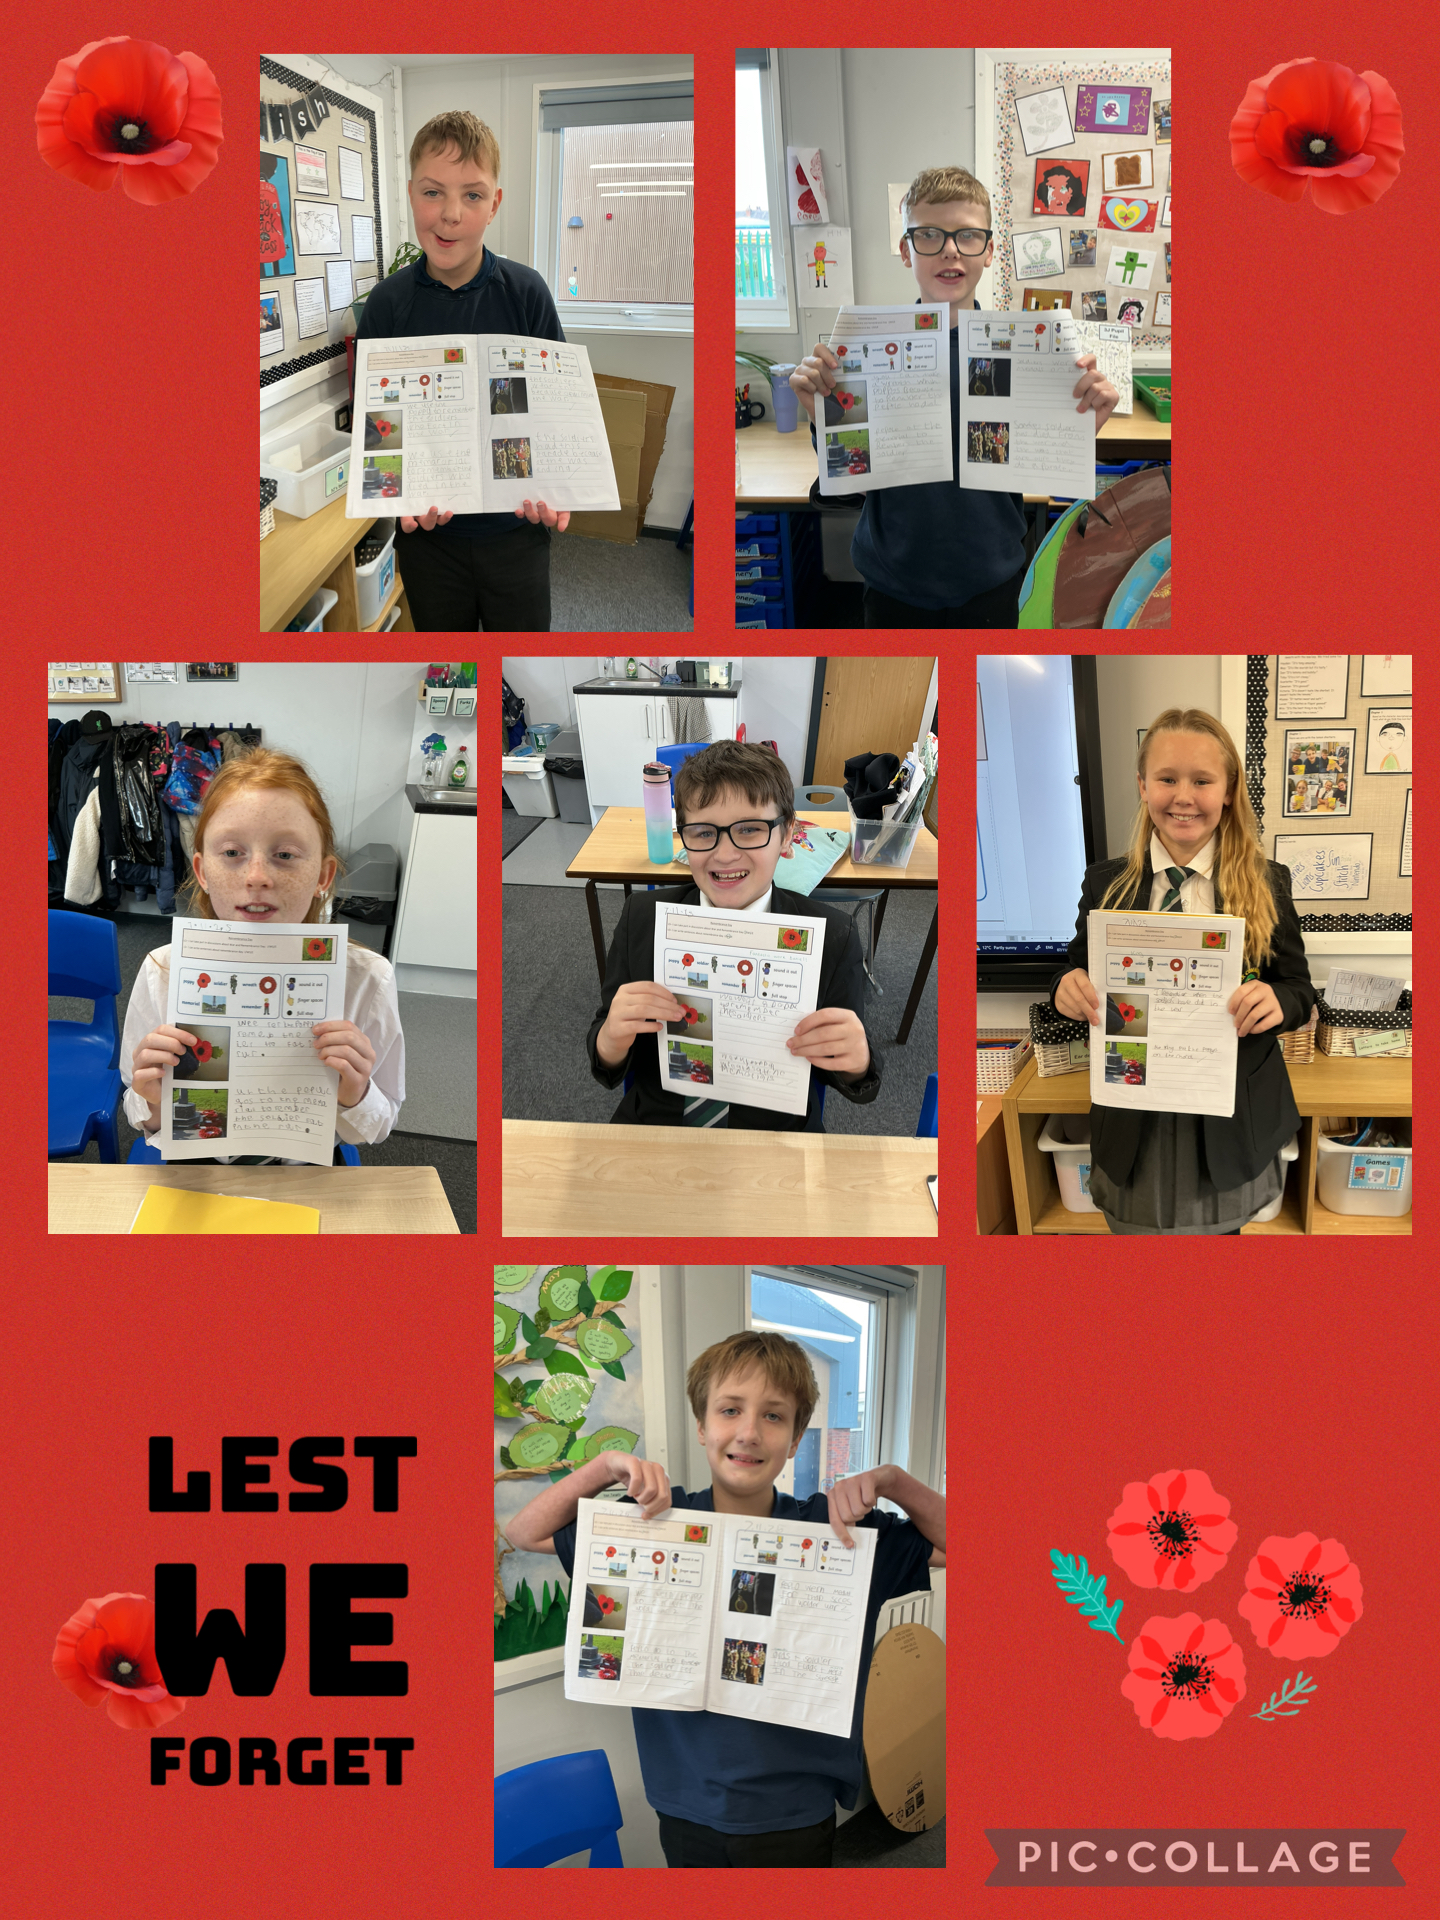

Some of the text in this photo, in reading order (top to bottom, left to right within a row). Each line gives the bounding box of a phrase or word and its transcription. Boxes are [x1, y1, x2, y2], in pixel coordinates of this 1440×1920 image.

[1308, 849, 1328, 893] Cupcakes
[1333, 864, 1349, 889] Stitch
[1366, 1158, 1391, 1167] Games
[542, 1270, 560, 1294] May
